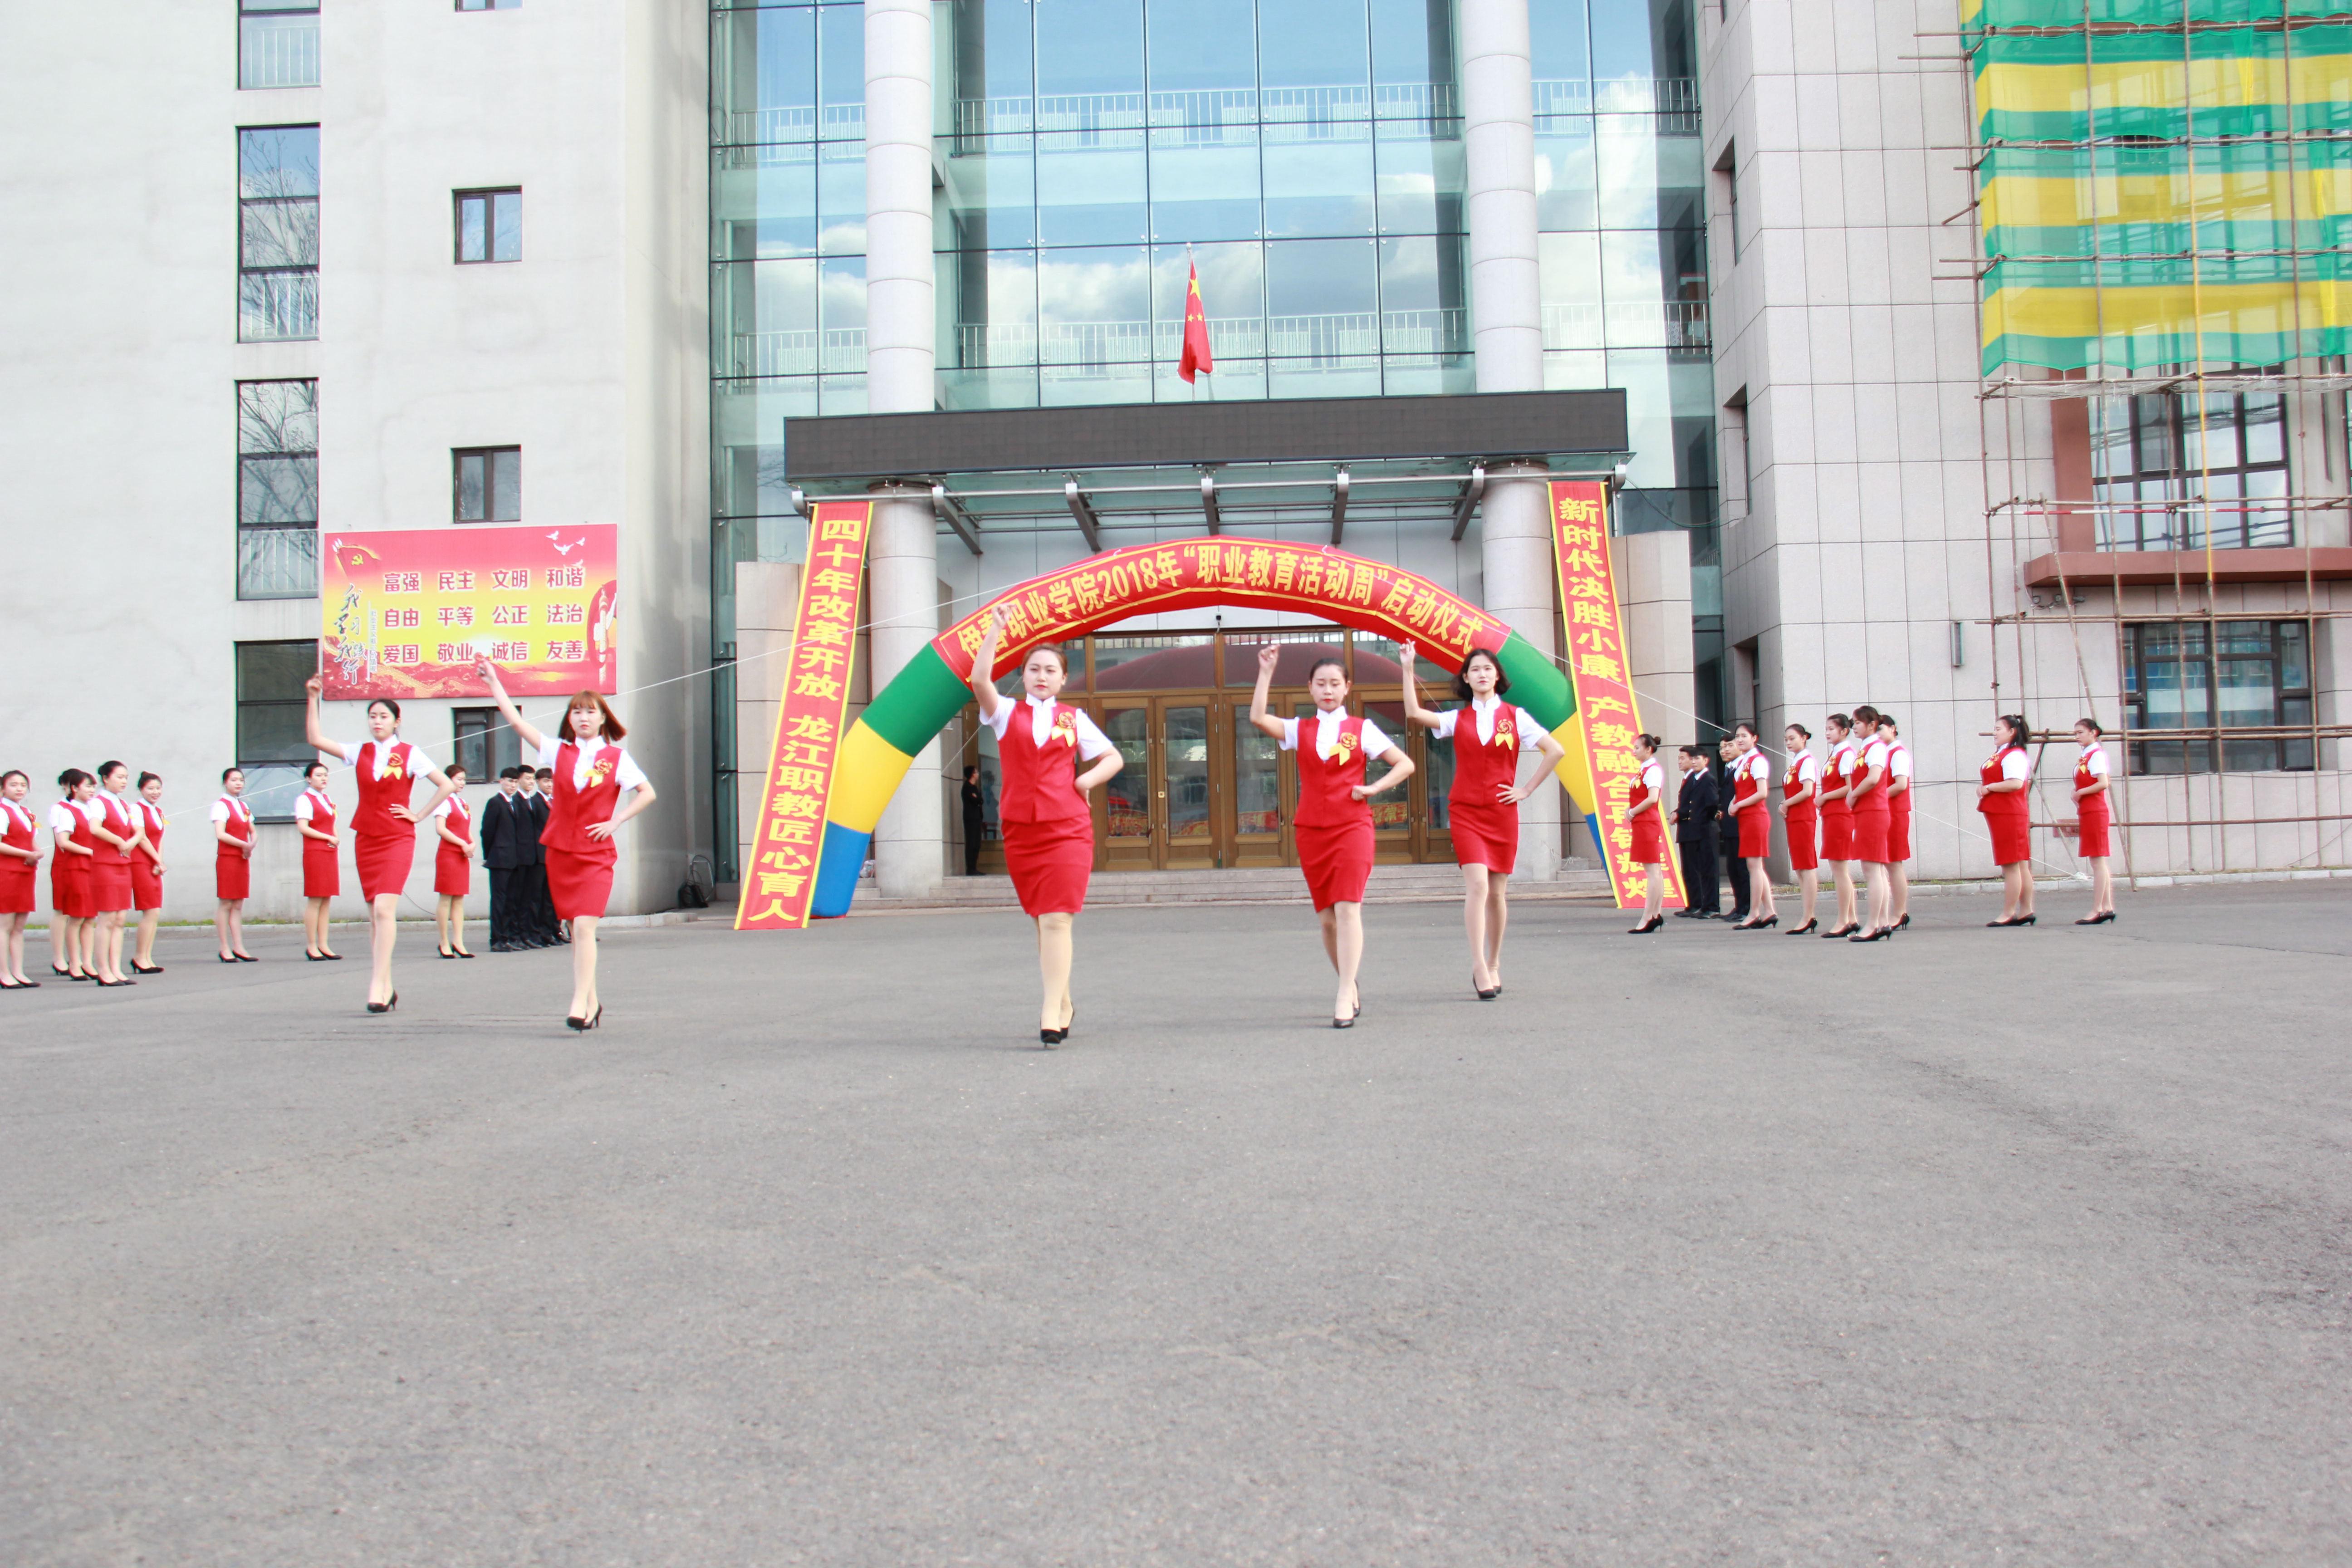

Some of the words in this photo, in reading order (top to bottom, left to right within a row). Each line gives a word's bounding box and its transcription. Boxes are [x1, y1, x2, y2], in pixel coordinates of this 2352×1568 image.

[385, 573, 420, 592] 富强
[439, 571, 474, 591] 民主
[492, 569, 528, 589] 文明
[547, 568, 584, 588] 和谐
[385, 608, 419, 627] 自由
[438, 606, 474, 627] 平等
[492, 605, 528, 625] 公正
[547, 603, 583, 624] 法治
[792, 519, 862, 701] 四十年改革开放
[1558, 497, 1623, 683] 新时代决胜小康
[383, 644, 419, 664] 爱国
[437, 642, 473, 662] 敬业
[492, 642, 528, 662] 诚信
[547, 640, 583, 660] 友善
[747, 714, 833, 922] 龙江职教匠心育人
